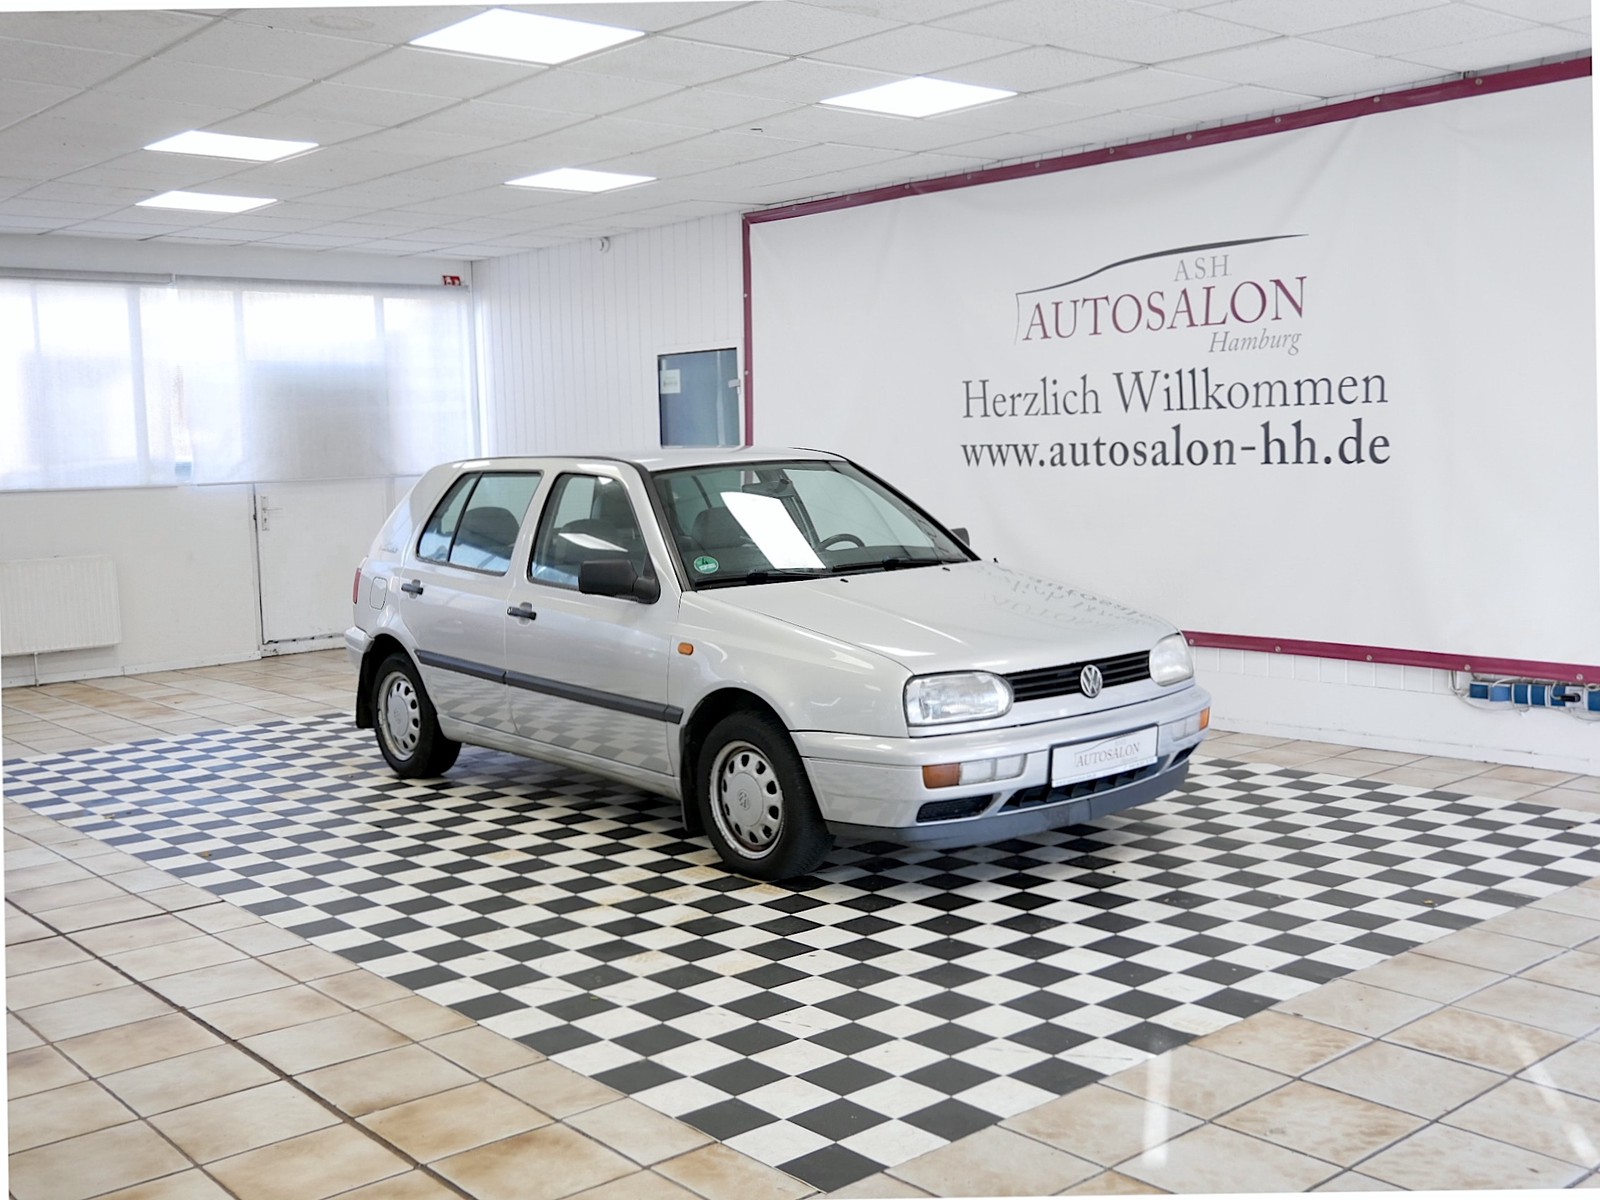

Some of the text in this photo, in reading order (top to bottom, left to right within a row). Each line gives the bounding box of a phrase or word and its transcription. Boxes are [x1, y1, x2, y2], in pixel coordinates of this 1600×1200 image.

[1022, 275, 1307, 341] AUTOSALON
[1208, 328, 1302, 356] Hamburg
[962, 366, 1389, 418] Herzlich Willkommen
[960, 417, 1391, 468] www.autosalon-hh.de
[1076, 741, 1141, 767] AUTOSALON
